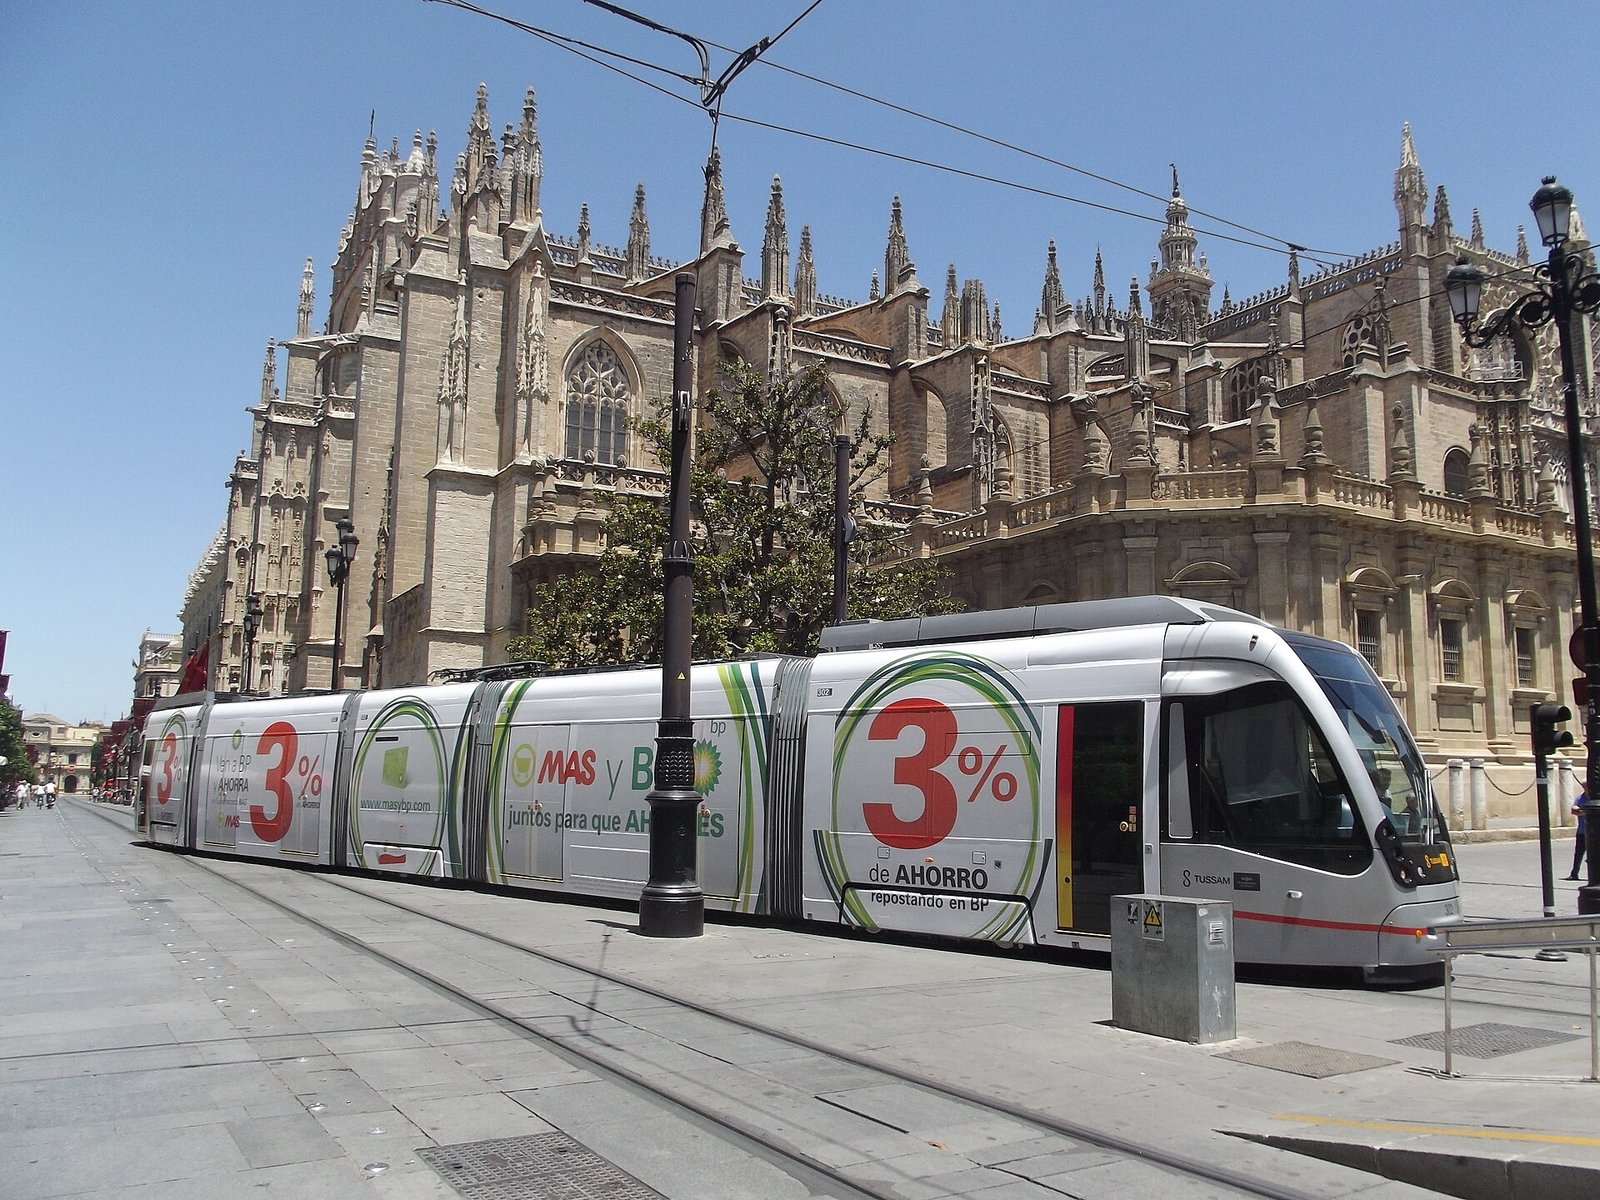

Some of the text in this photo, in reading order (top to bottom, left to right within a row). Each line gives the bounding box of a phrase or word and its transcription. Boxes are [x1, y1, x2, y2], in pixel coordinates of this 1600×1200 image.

[710, 720, 726, 737] bp
[239, 754, 252, 773] BP
[537, 749, 597, 786] MAS
[606, 759, 623, 801] y
[218, 777, 249, 792] AHORRA
[360, 797, 431, 813] www.masybp.com
[225, 815, 240, 828] MAS
[508, 804, 551, 830] juntos
[555, 811, 587, 833] para
[591, 814, 621, 835] que
[869, 863, 988, 890] de AHORRO
[1194, 875, 1231, 884] TUSSAM
[871, 891, 989, 911] repostando en BP
